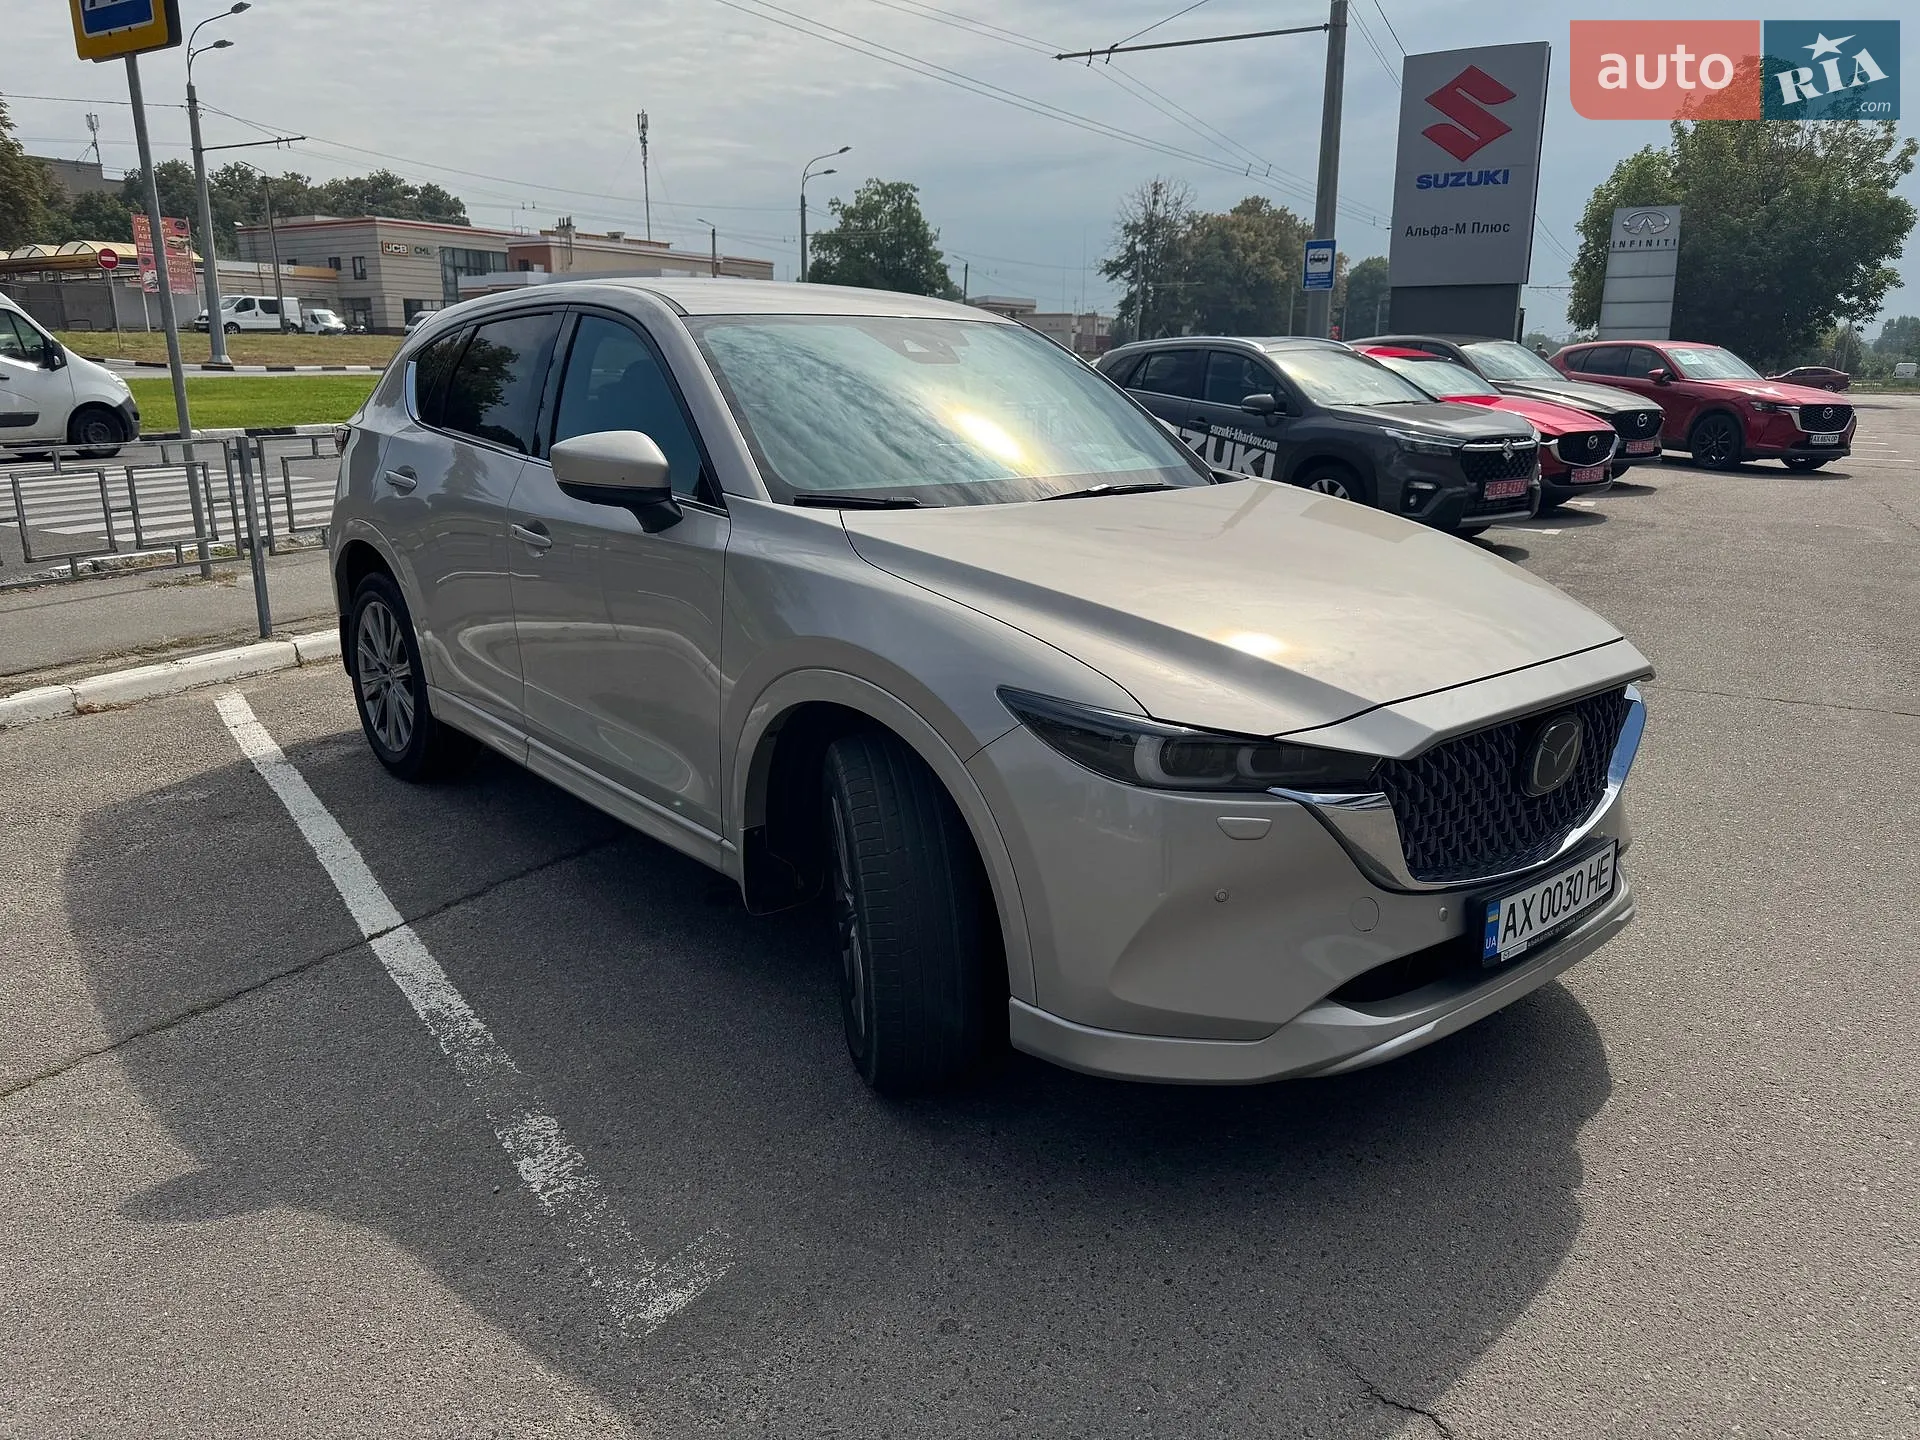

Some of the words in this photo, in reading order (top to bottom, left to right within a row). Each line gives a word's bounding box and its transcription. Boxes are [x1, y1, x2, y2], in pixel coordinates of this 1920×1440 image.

[1416, 169, 1509, 189] SUZUKI
[1405, 222, 1466, 238] Альфа-М
[1471, 221, 1511, 234] Плюс
[385, 243, 408, 253] JCB
[414, 246, 431, 256] CML
[1612, 238, 1677, 249] INFINITI
[1209, 424, 1278, 451] suzuki-kharkov.com
[1173, 425, 1276, 480] ZUKI
[1502, 893, 1537, 944] AX
[1540, 869, 1584, 924] 0030
[1586, 851, 1611, 899] HE
[1485, 935, 1497, 950] UA
